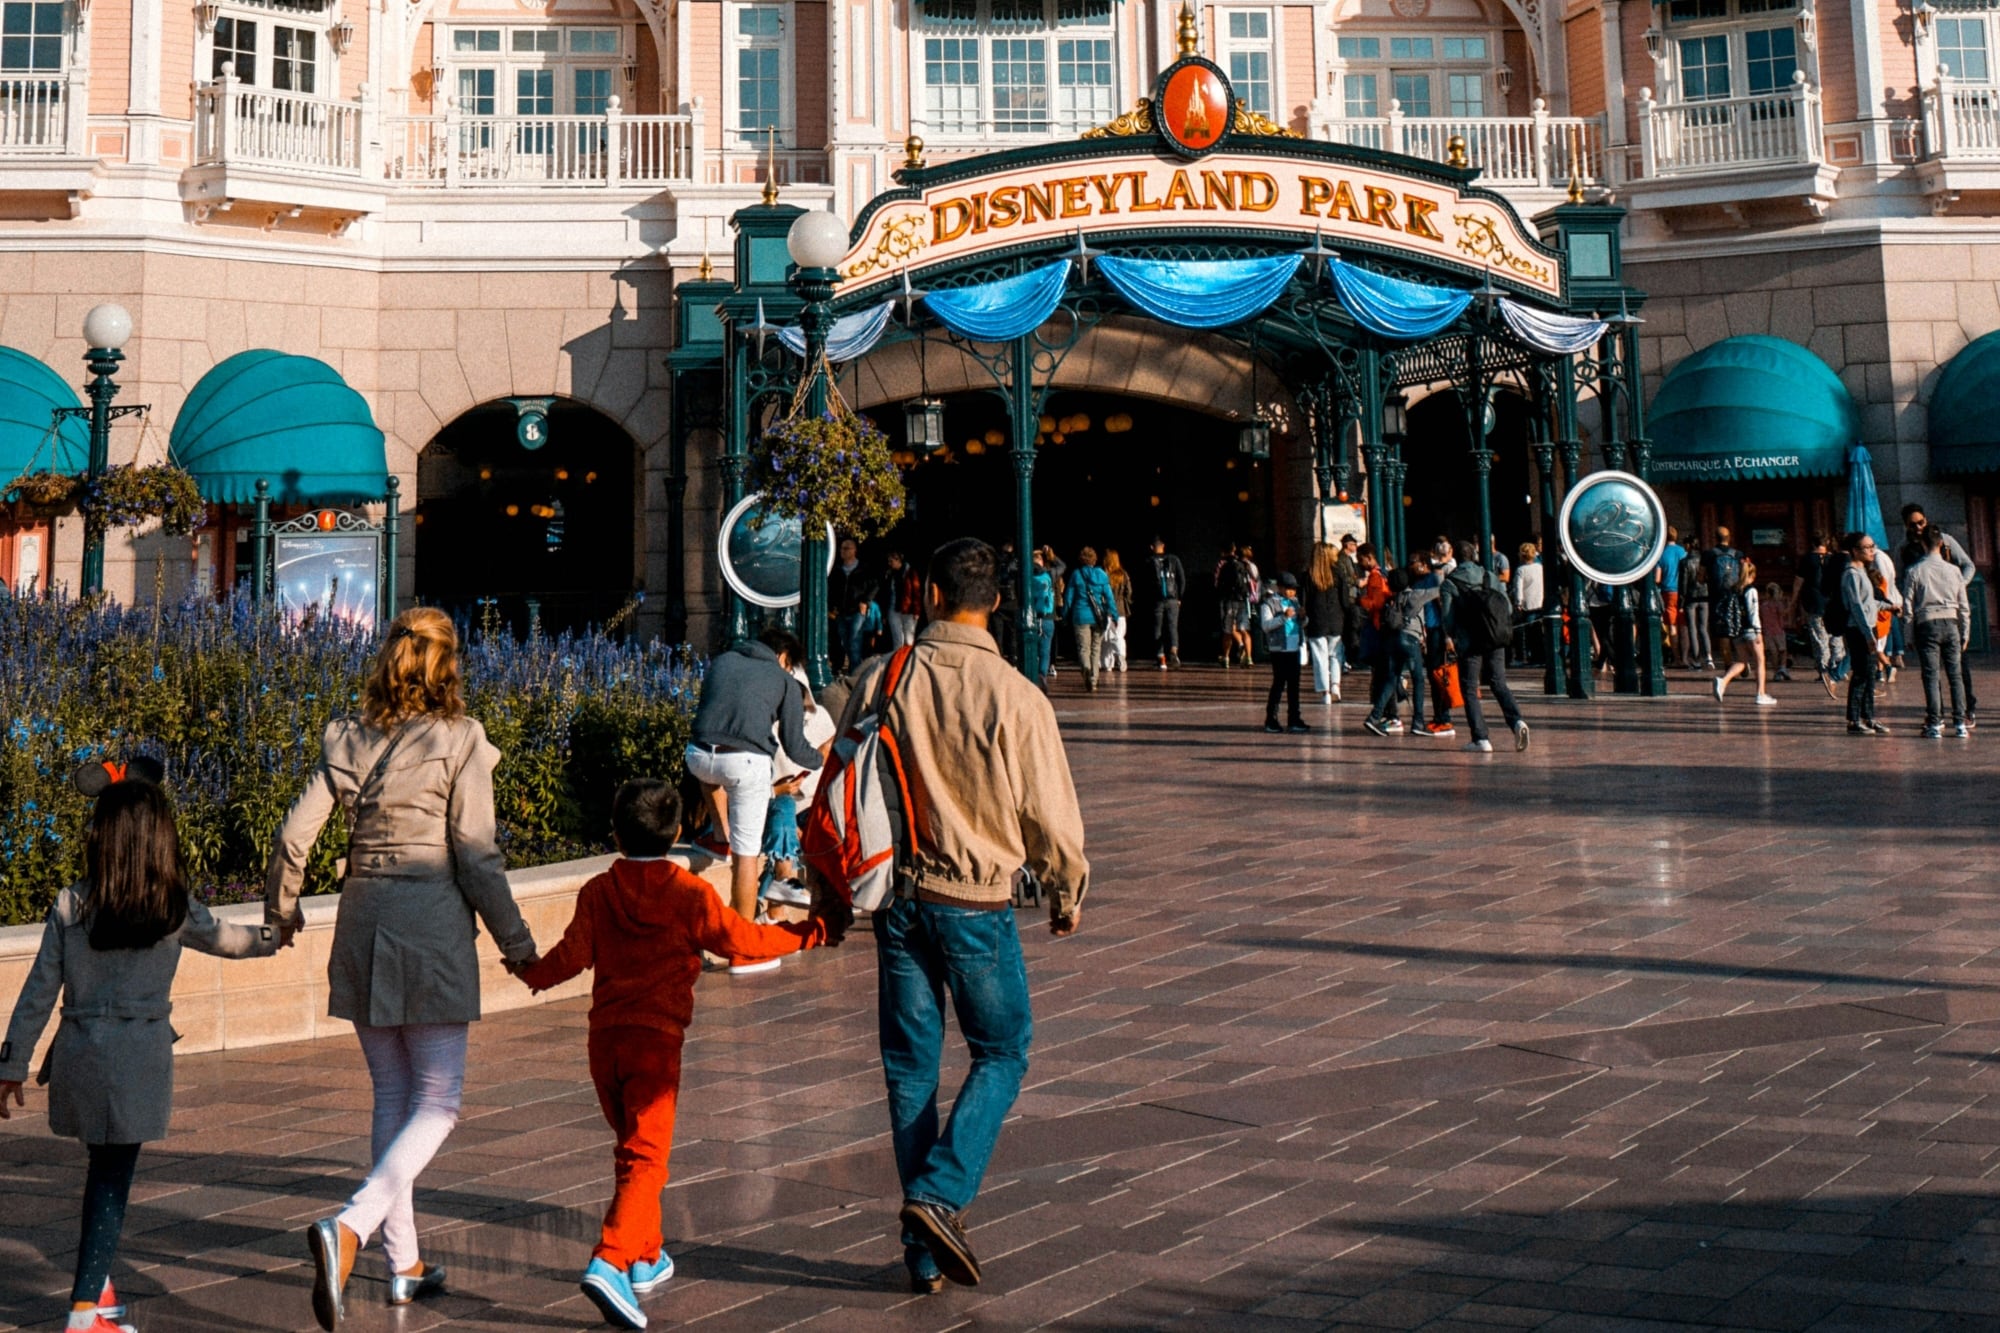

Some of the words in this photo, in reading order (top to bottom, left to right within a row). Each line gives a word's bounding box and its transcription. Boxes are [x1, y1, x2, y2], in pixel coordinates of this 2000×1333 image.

[930, 169, 1279, 246] DISNEYLAND
[1298, 174, 1444, 243] PARK
[525, 423, 540, 441] 8
